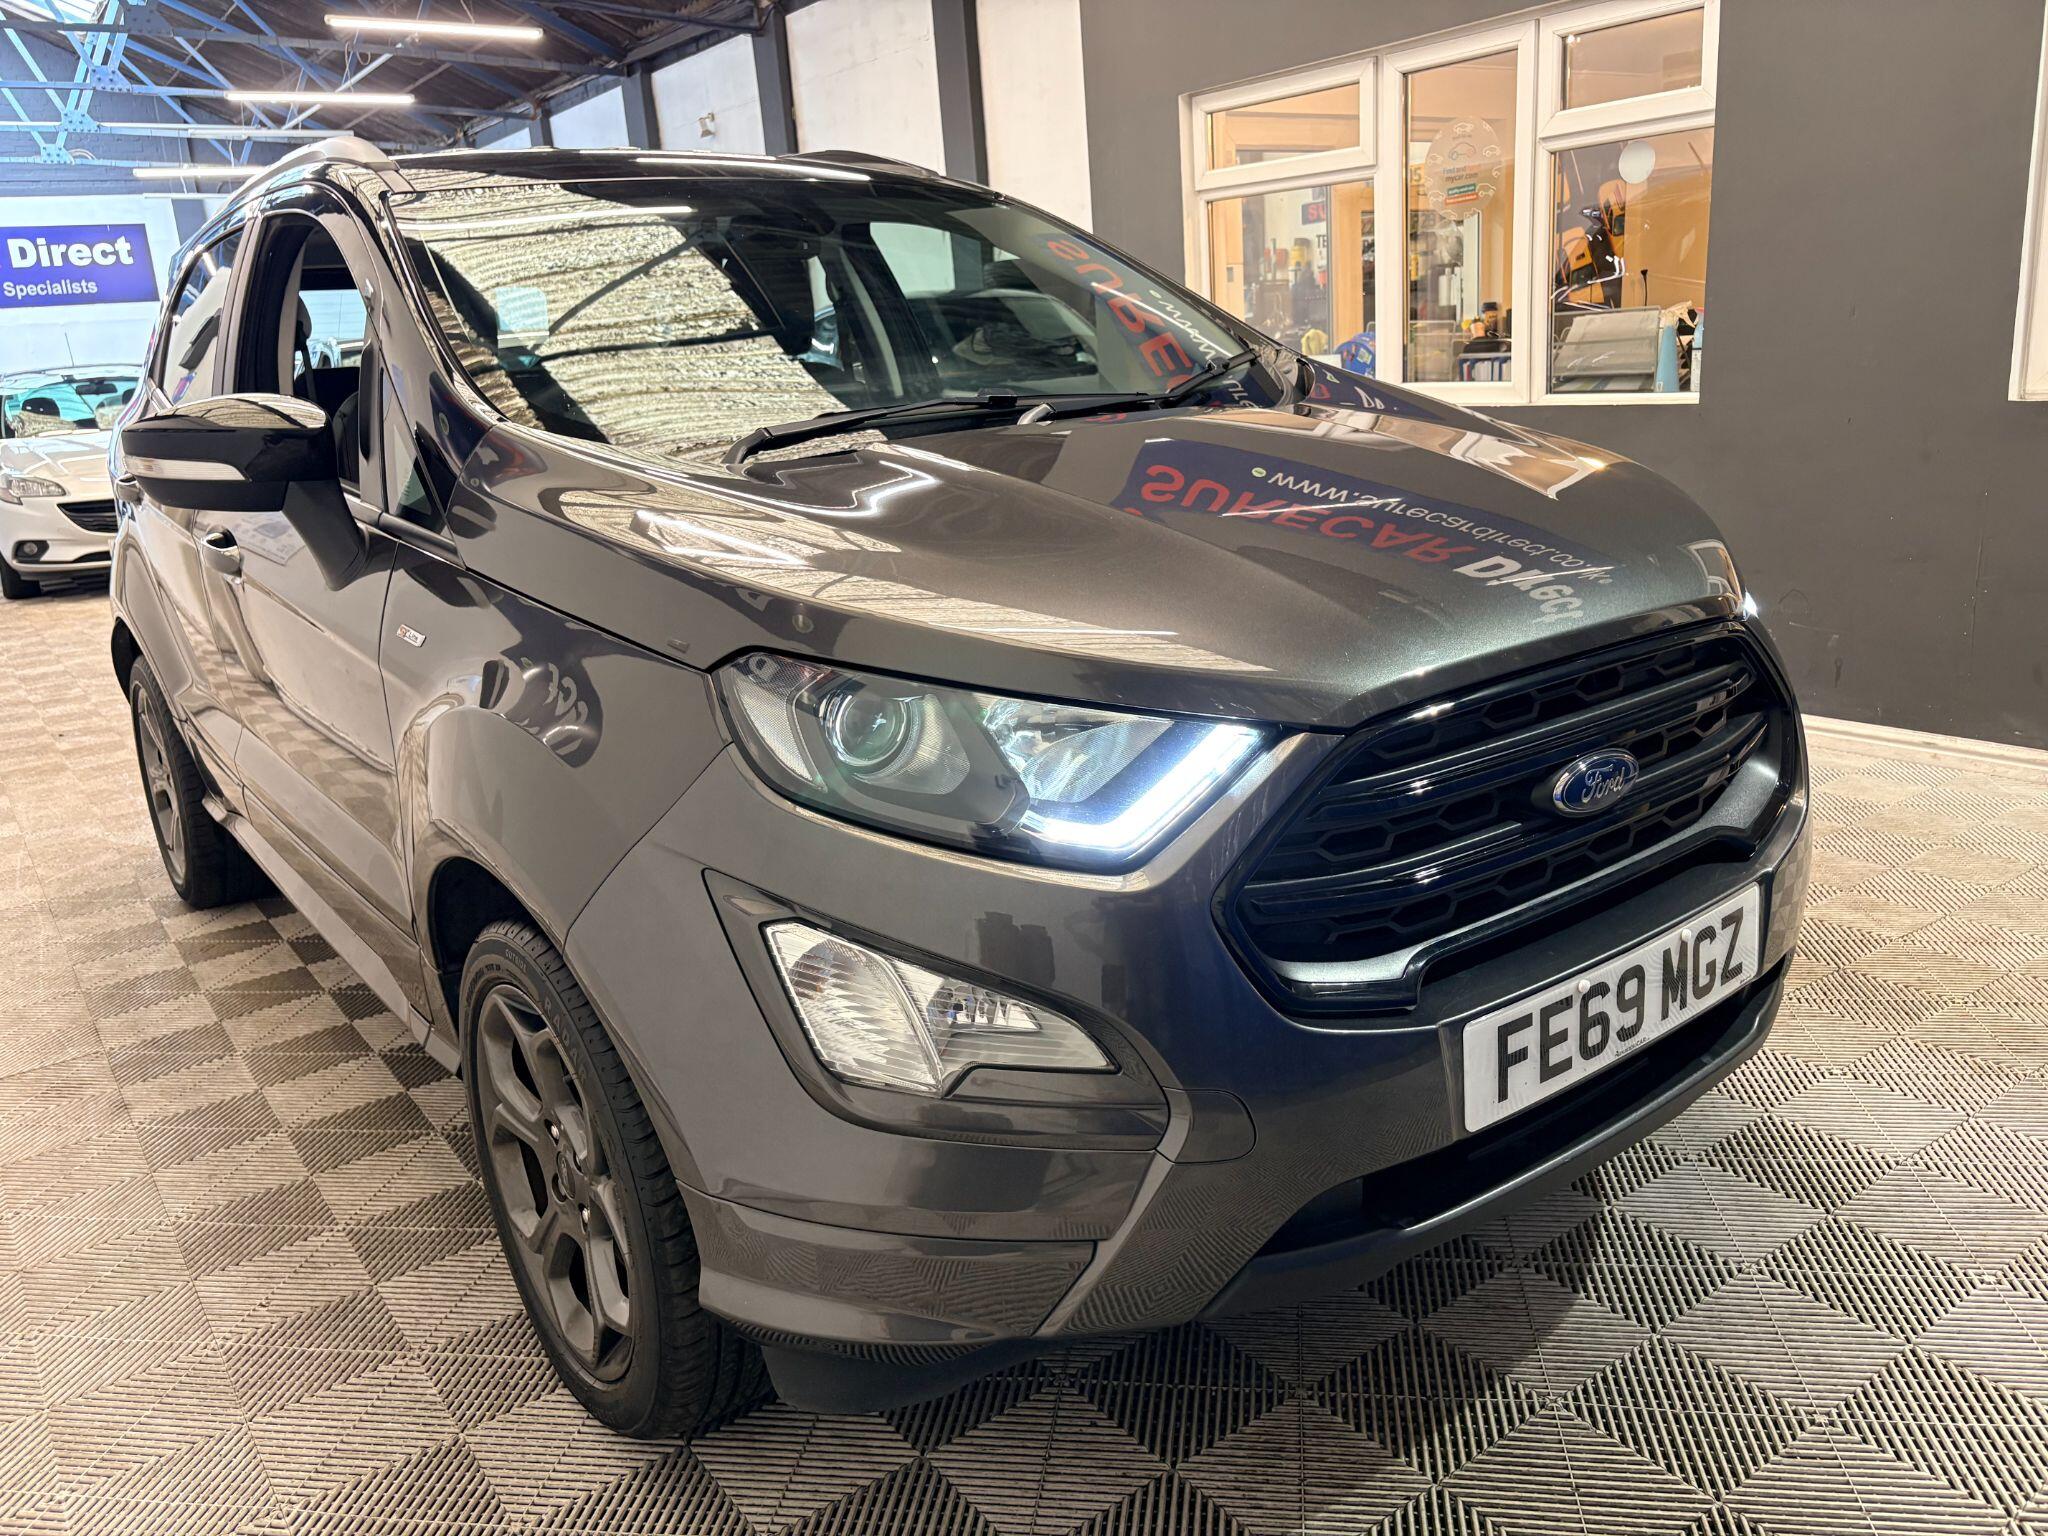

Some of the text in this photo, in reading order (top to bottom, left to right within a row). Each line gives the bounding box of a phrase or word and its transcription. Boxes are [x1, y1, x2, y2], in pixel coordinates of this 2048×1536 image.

[7, 235, 134, 269] Direct
[3, 279, 98, 300] Specialists
[1581, 764, 1626, 803] Ford
[1497, 906, 1744, 1103] FE69 MGZ
